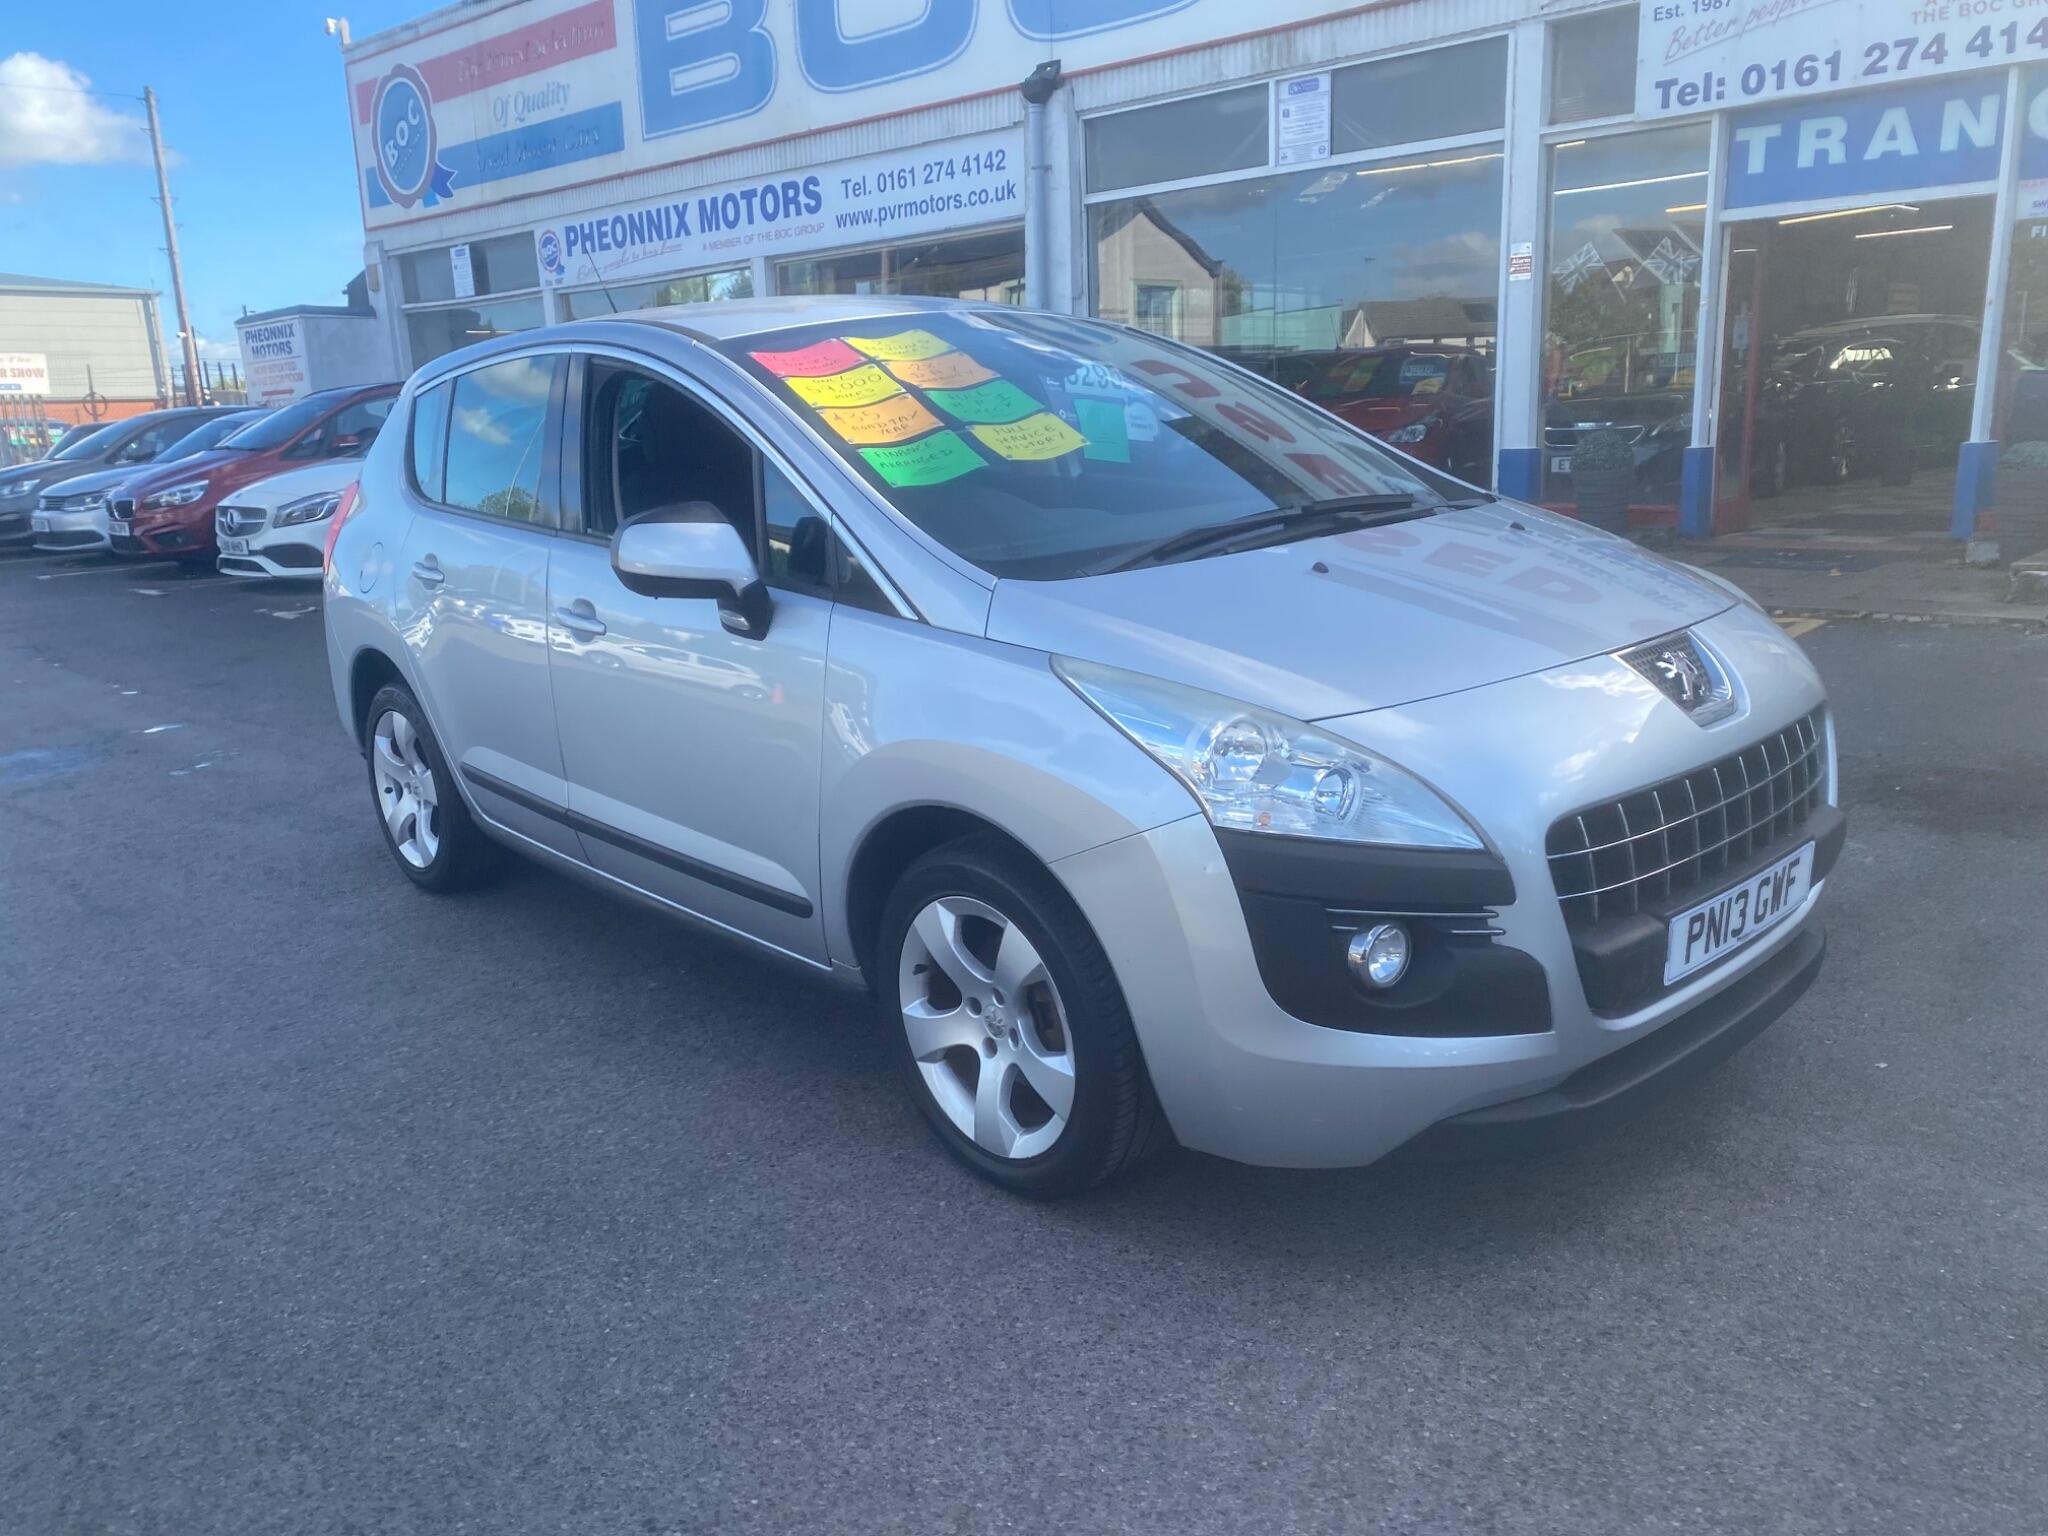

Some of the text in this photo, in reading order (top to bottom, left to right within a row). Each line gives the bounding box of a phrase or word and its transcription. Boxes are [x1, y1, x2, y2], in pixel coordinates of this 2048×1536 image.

[1654, 4, 1684, 21] Est.
[1912, 5, 1949, 25] THE
[1959, 0, 2001, 17] BOC
[1664, 18, 1738, 60] Better
[1654, 71, 1726, 109] Tel:
[1740, 49, 1842, 96] 0161
[1862, 32, 1948, 76] 274
[493, 80, 570, 127] Of Quality
[385, 98, 420, 168] BOC
[841, 149, 1006, 199] Tel. 0161 274 4142
[565, 175, 822, 257] PHEONNIX MOTORS
[835, 179, 1017, 229] www.pvrmotors.co.uk
[708, 237, 742, 250] MEMBER
[743, 233, 756, 245] OF
[757, 231, 774, 243] THE
[774, 227, 793, 239] BOC
[794, 222, 825, 236] GROUP
[245, 323, 295, 344] PHEONNIX
[252, 340, 293, 356] MOTORS
[995, 425, 1057, 446] SERVICE
[1684, 857, 1800, 964] PN13 GWF
